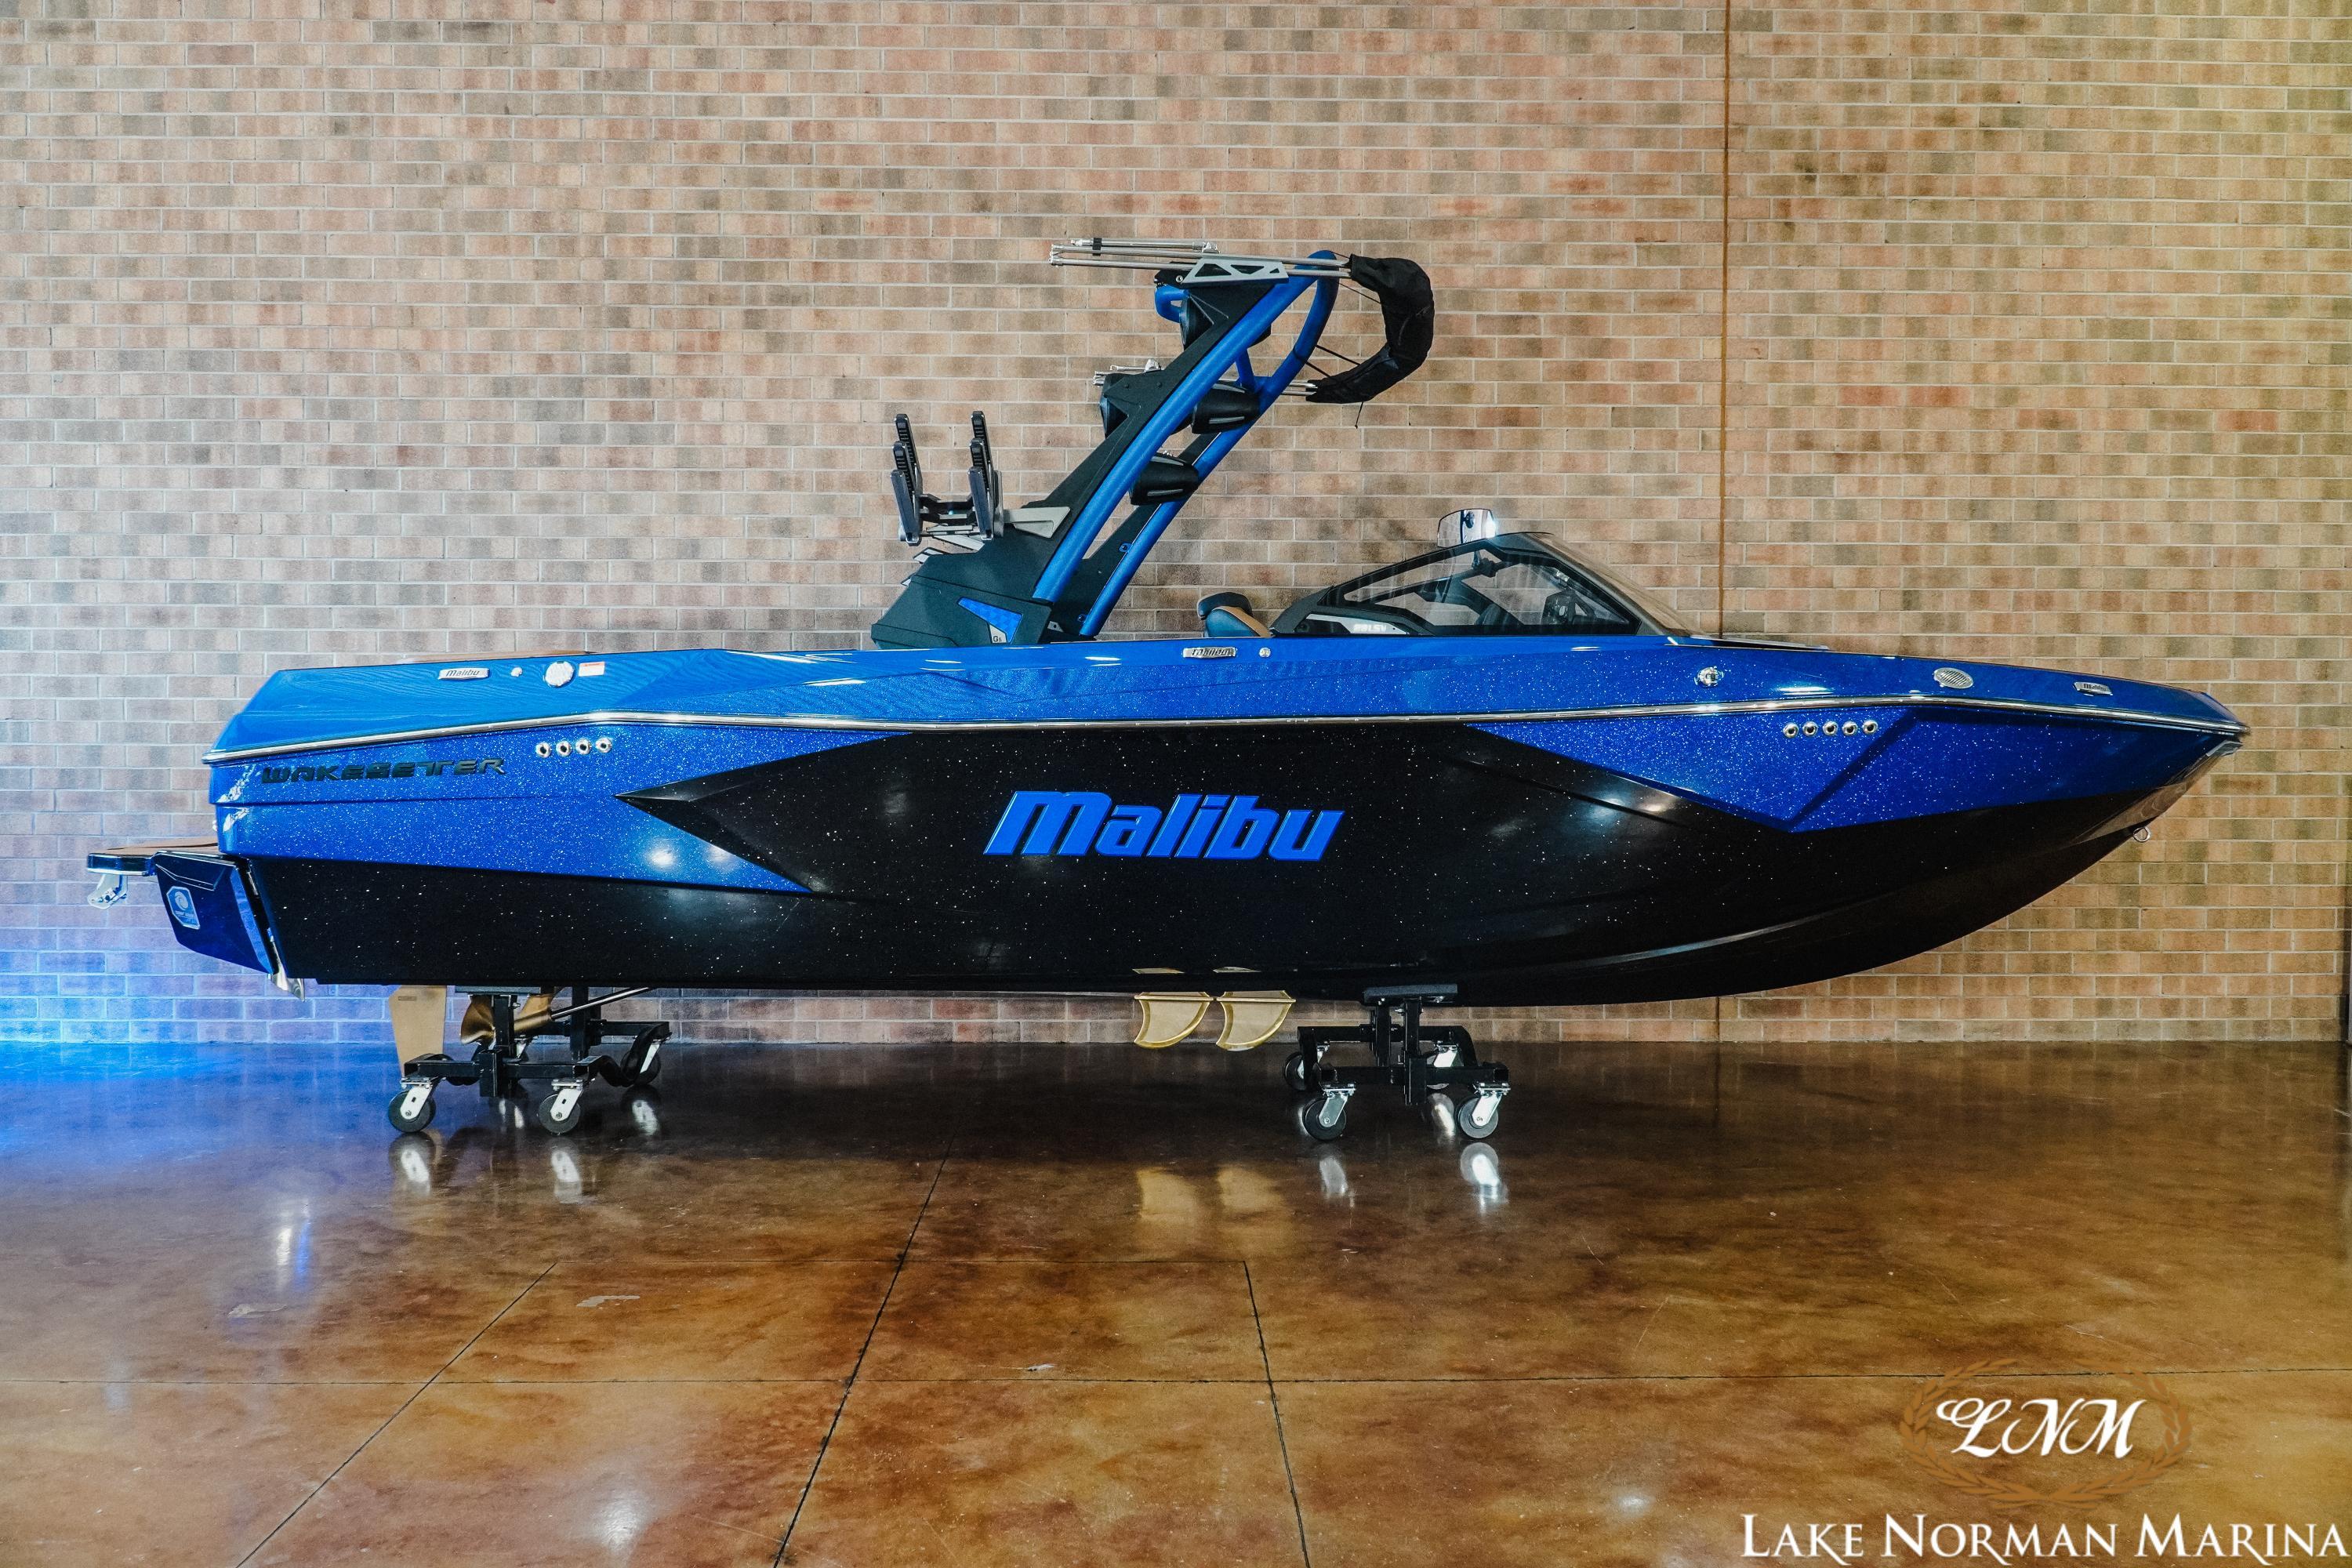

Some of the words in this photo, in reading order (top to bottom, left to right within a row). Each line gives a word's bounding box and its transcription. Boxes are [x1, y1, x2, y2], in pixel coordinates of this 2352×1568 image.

[445, 669, 480, 677] Malibu
[261, 757, 506, 784] WAKESETTER
[982, 790, 1345, 862] Malibu
